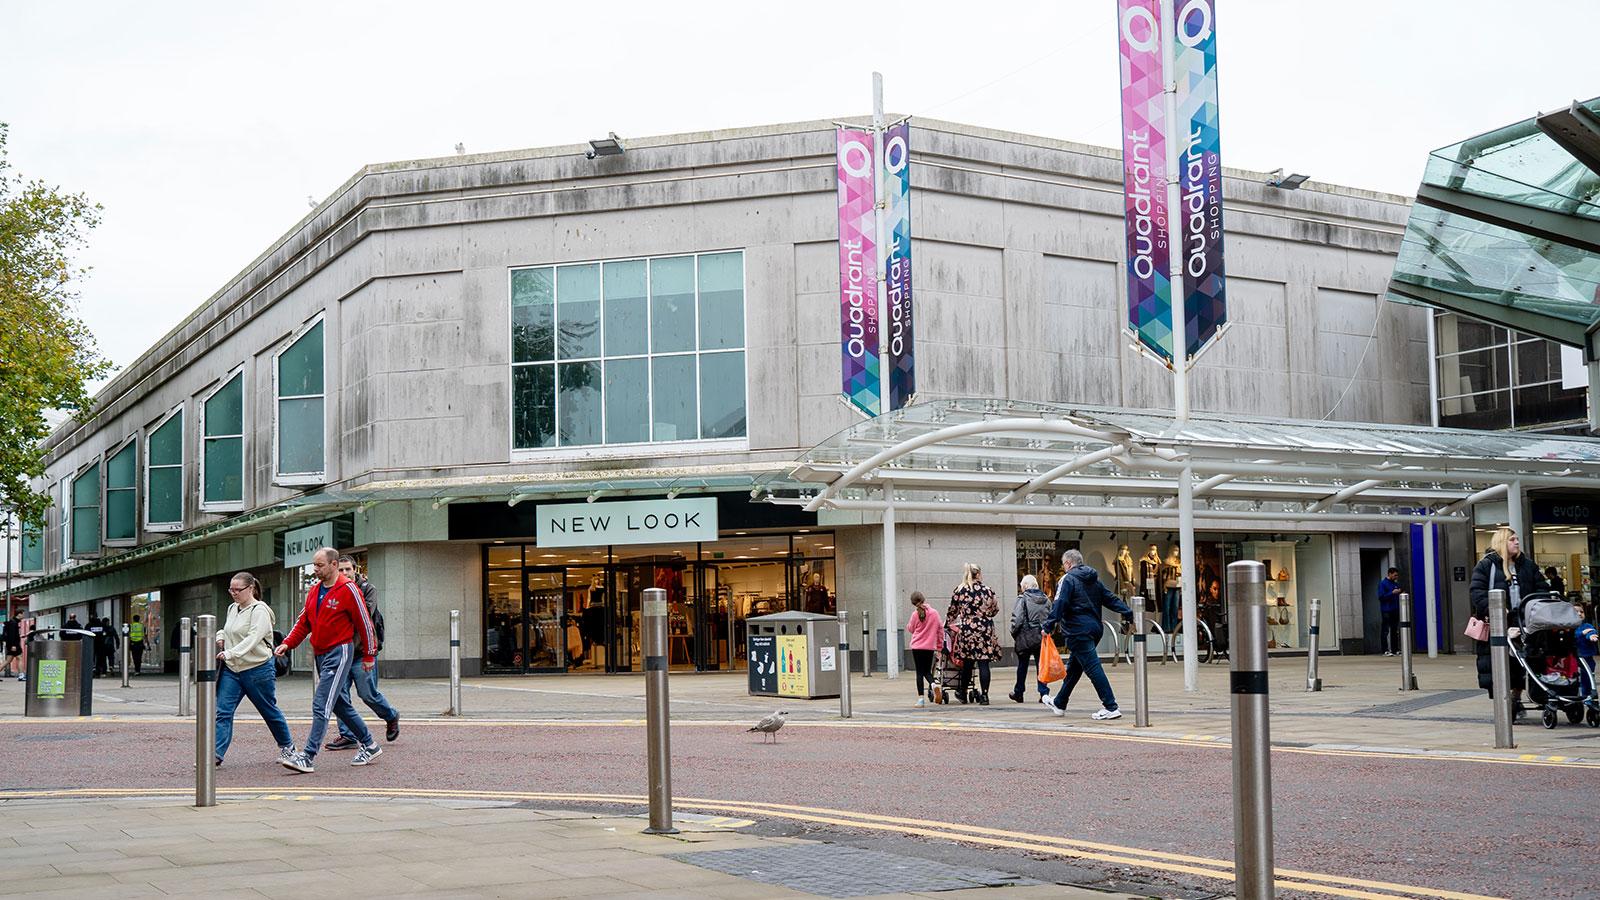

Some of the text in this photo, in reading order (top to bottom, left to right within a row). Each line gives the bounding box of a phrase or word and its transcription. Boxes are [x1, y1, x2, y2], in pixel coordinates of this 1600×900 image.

[1121, 5, 1159, 54] Q
[1176, 0, 1212, 48] Q
[840, 140, 872, 178] Q
[884, 135, 907, 175] Q
[1127, 129, 1154, 280] Quadrant
[1156, 165, 1167, 249] SHOPPING
[1183, 126, 1207, 278] Quadrant
[1207, 153, 1220, 240] SHOPPING
[843, 239, 865, 358] Quadrant
[866, 266, 877, 334] SHOPPING
[888, 236, 904, 356] Quadrant
[903, 259, 912, 327] SHOPPING
[287, 536, 324, 556] NEW LOOK
[551, 512, 701, 533] NEW LOOK
